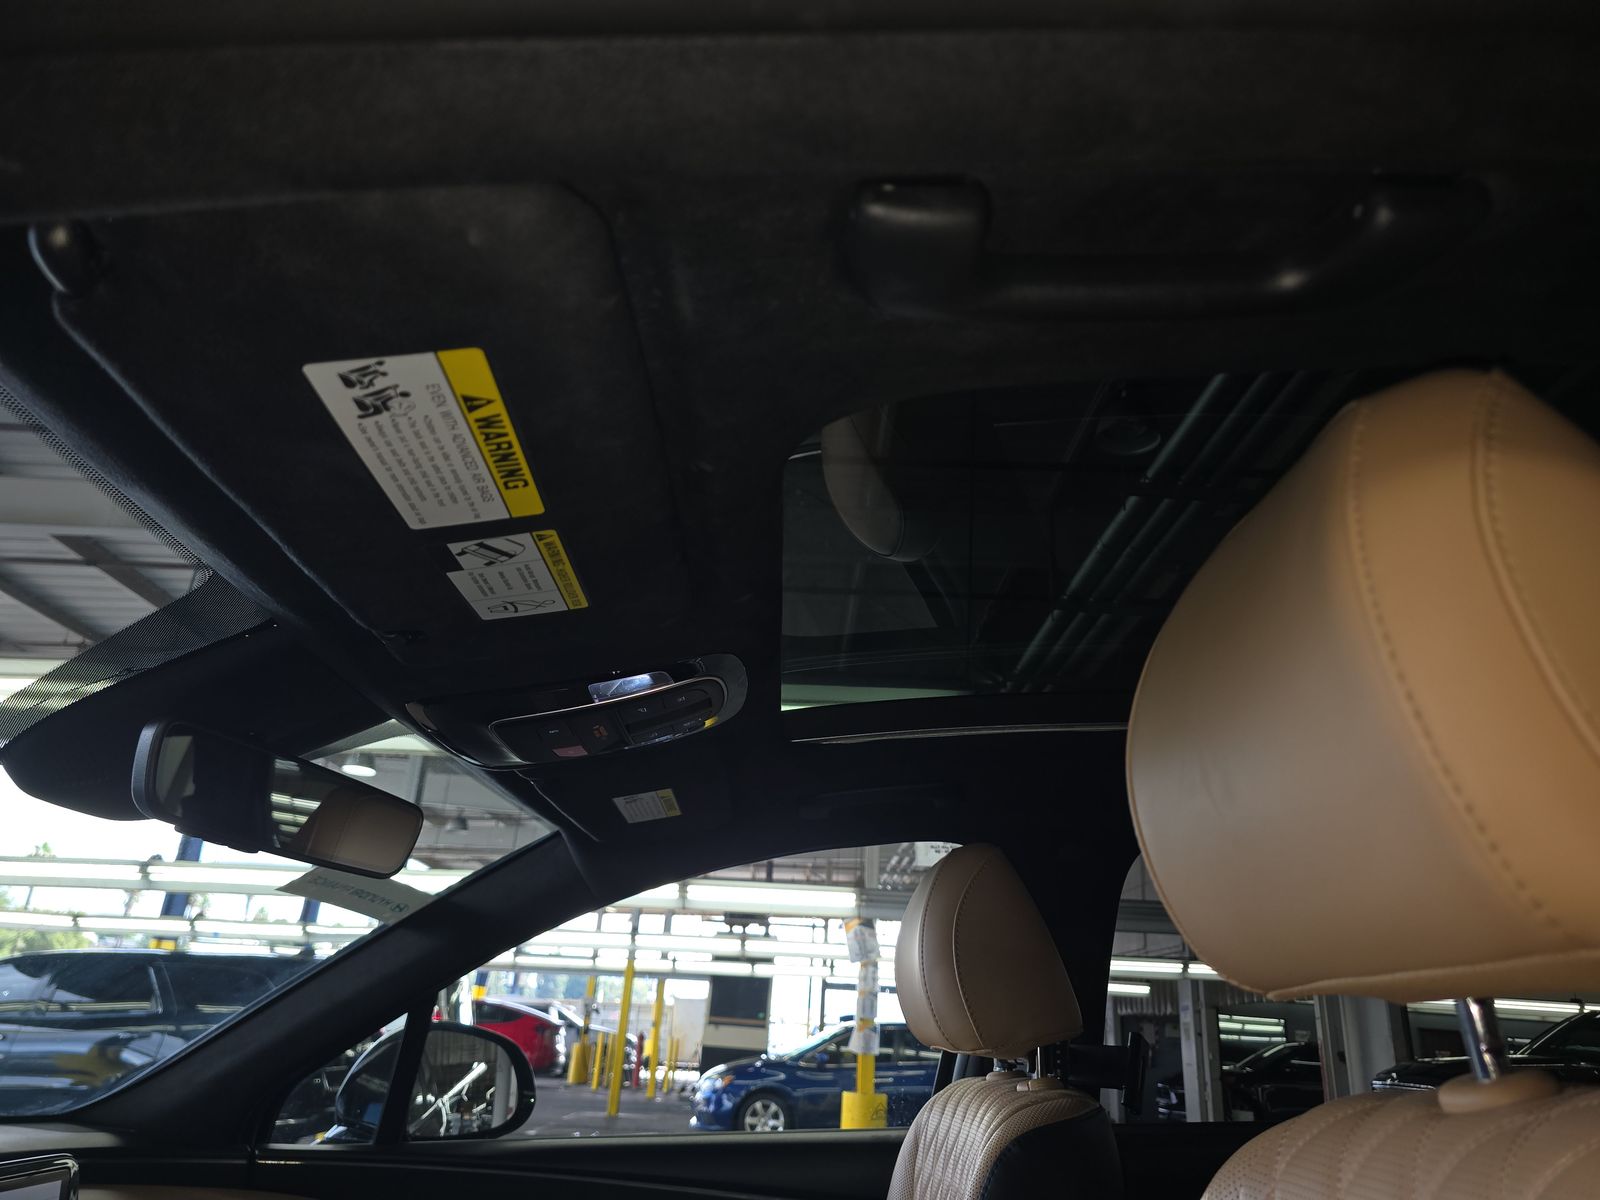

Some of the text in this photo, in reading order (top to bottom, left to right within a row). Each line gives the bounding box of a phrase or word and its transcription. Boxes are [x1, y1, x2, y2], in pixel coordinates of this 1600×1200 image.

[425, 383, 495, 503] EVEN WITH ADVANCED AIR BAGS
[473, 413, 529, 490] WARNING
